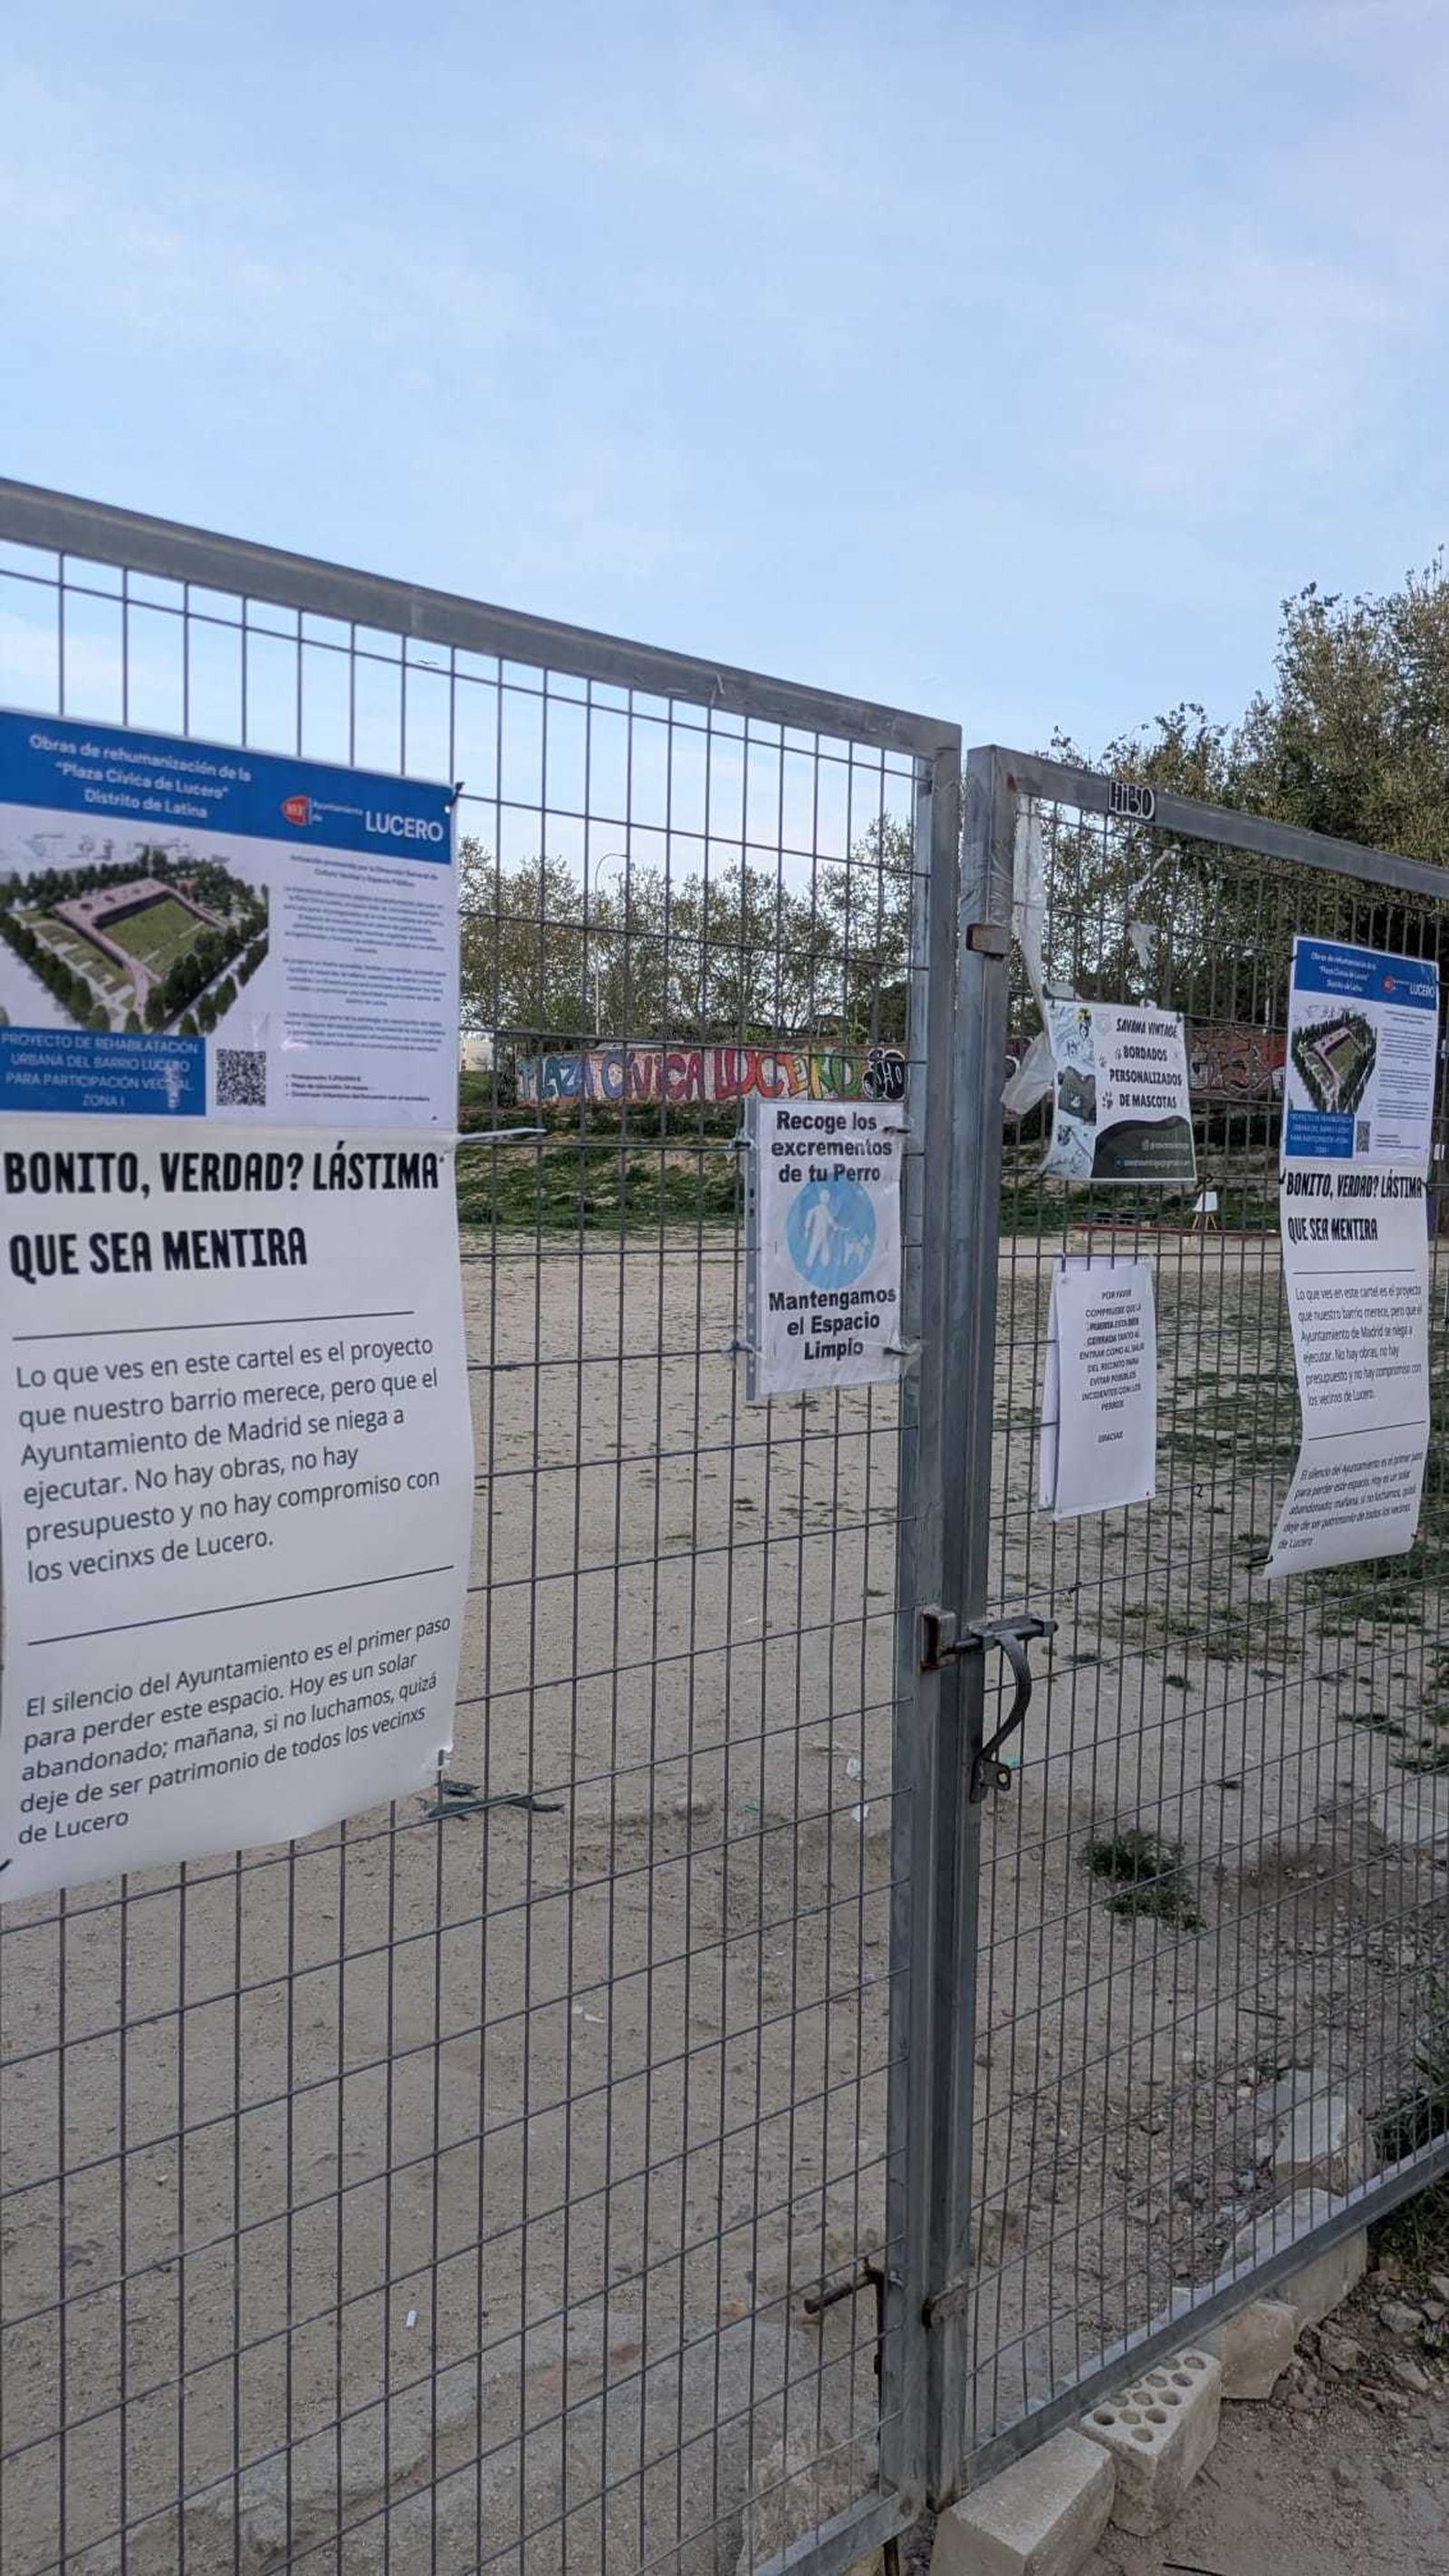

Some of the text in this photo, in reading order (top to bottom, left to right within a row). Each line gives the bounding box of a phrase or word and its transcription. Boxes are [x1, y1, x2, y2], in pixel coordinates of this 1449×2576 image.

[29, 735, 252, 782] Obras de rehumanización de la
[154, 776, 173, 792] de
[84, 789, 208, 819] Distrito de Latina
[365, 811, 444, 841] LUCERO
[1409, 984, 1435, 998] LUCERO
[1, 1033, 73, 1048] PROYECTO
[75, 1037, 92, 1049] DE
[1148, 1022, 1177, 1038] VINTAGE
[11, 1053, 64, 1067] URBANA
[67, 1056, 90, 1069] DEL
[93, 1057, 139, 1070] BARRIO
[1123, 1044, 1167, 1062] BORDADOS
[5, 1072, 40, 1085] PARA
[43, 1074, 138, 1090] PARTICIPACIÓN
[1109, 1068, 1182, 1087] PERSONALIZADOS
[82, 1094, 118, 1107] ZONA
[1119, 1093, 1176, 1109] DE MASCOTAS
[776, 1110, 878, 1135] Recoge los
[771, 1139, 892, 1156] excrementos
[5, 1140, 438, 1198] BONITO, VERDAD? LÁSTIMA
[779, 1163, 880, 1183] de tu Perro
[1287, 1169, 1422, 1198] BONITO, VERDAD? LÁSTIMA
[1288, 1217, 1377, 1245] QUE SEA MENTIRA
[10, 1227, 307, 1284] QUE SEA MENTIRA
[769, 1288, 897, 1312] Mantengamos
[787, 1311, 880, 1337] el Espacio
[804, 1338, 863, 1361] Limpio
[16, 1338, 433, 1390] Lo que ves en este cartel es el proyecto
[19, 1368, 437, 1433] que nuestro barrio merece, pero que el
[21, 1409, 404, 1470] Ayuntamiento de Madrid se niega a
[24, 1447, 359, 1509] ejecutar. No hay obras, no hay
[26, 1472, 439, 1550] presupuesto y no hay compromiso con
[28, 1532, 273, 1583] los vecinxs de Lucero.
[27, 1618, 450, 1717] El silencio del Ayuntamiento es el primer paso
[24, 1654, 417, 1754] para perder este espacio. Hoy es un solar
[22, 1672, 437, 1781] abandonado; mañana, si no luchamos, quizá
[21, 1707, 425, 1813] deje de ser patrimonio de todos los vecinxs
[18, 1812, 129, 1844] de Lucero
